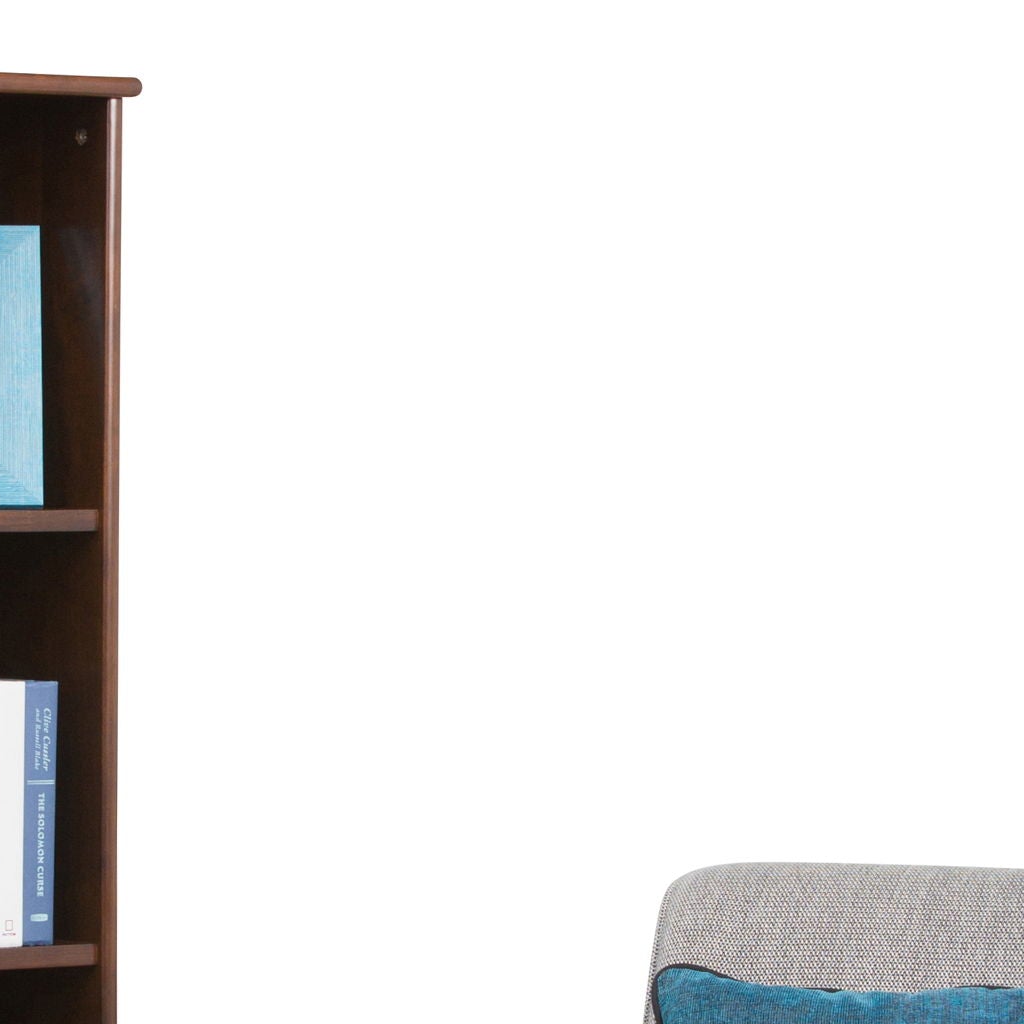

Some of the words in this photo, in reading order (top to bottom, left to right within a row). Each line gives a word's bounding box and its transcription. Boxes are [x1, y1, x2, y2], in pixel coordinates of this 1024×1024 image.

[43, 707, 52, 734] Clive
[42, 735, 51, 772] Cussler
[37, 792, 45, 812] THE
[37, 813, 45, 864] SOLOMON
[36, 866, 45, 897] CURSE
